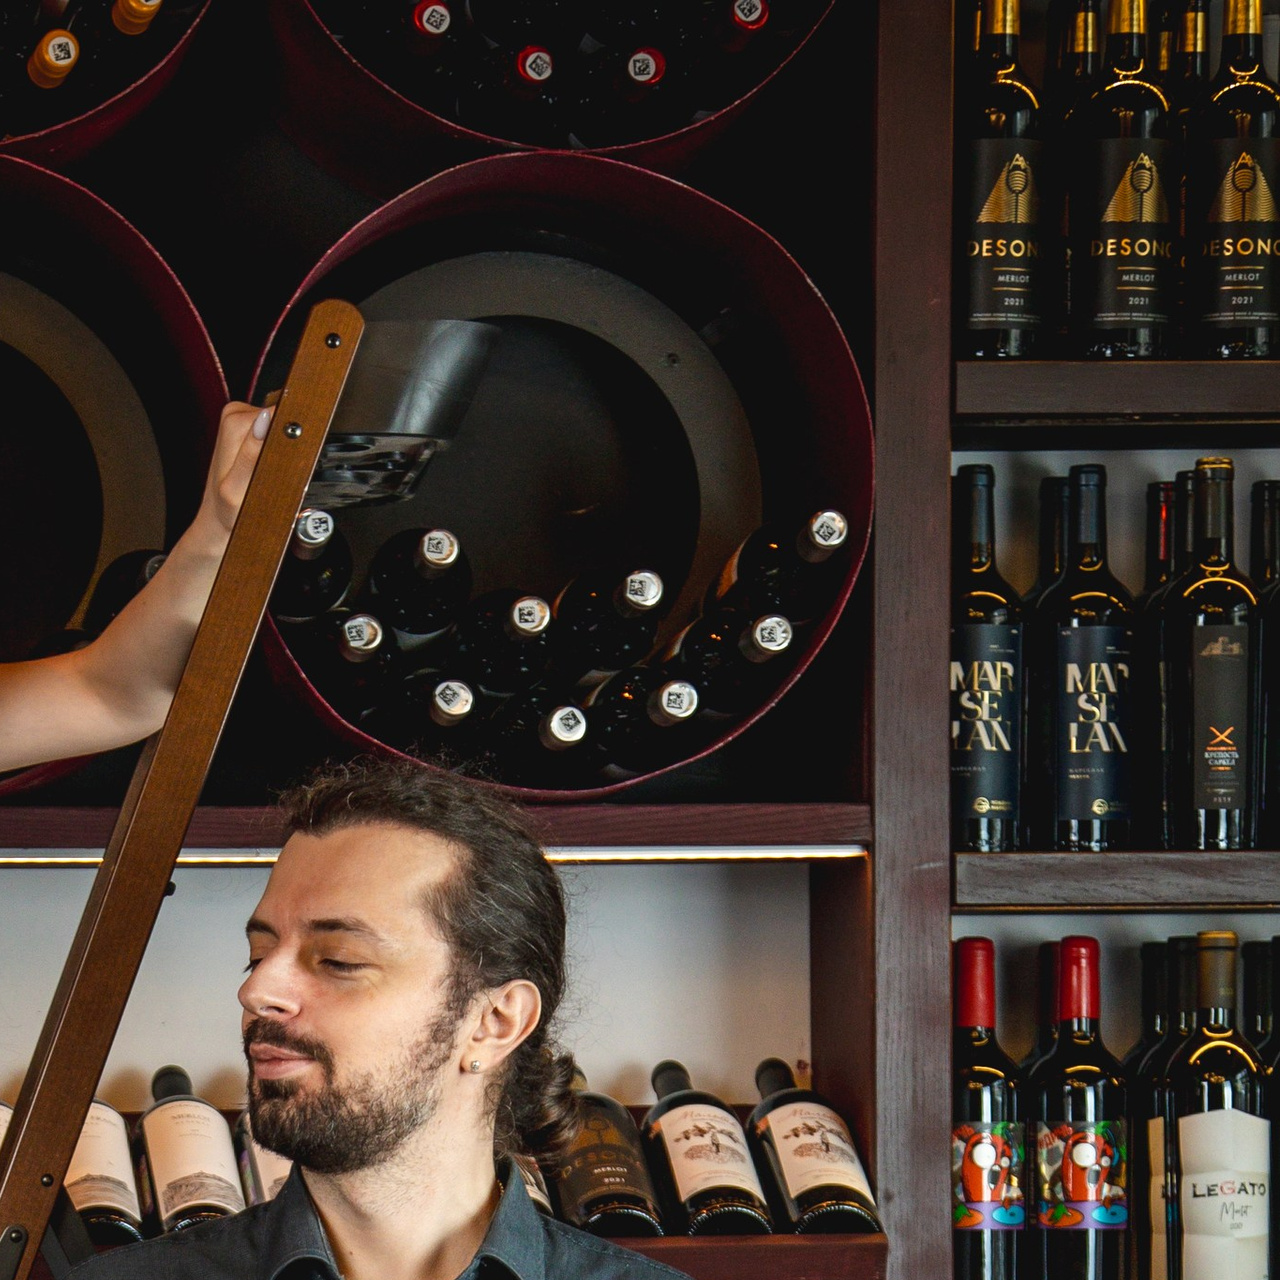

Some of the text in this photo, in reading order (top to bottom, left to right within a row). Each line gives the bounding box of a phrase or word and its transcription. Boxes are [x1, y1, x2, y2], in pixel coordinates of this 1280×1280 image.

[997, 274, 1030, 282] MERLOT
[1122, 274, 1155, 282] MERLOT
[1224, 273, 1260, 282] MERLOT
[1128, 297, 1149, 305] 2021
[1231, 296, 1253, 304] 2021
[950, 661, 1015, 692] MAR
[959, 690, 1003, 721] SE
[1192, 1181, 1267, 1198] LEGATO
